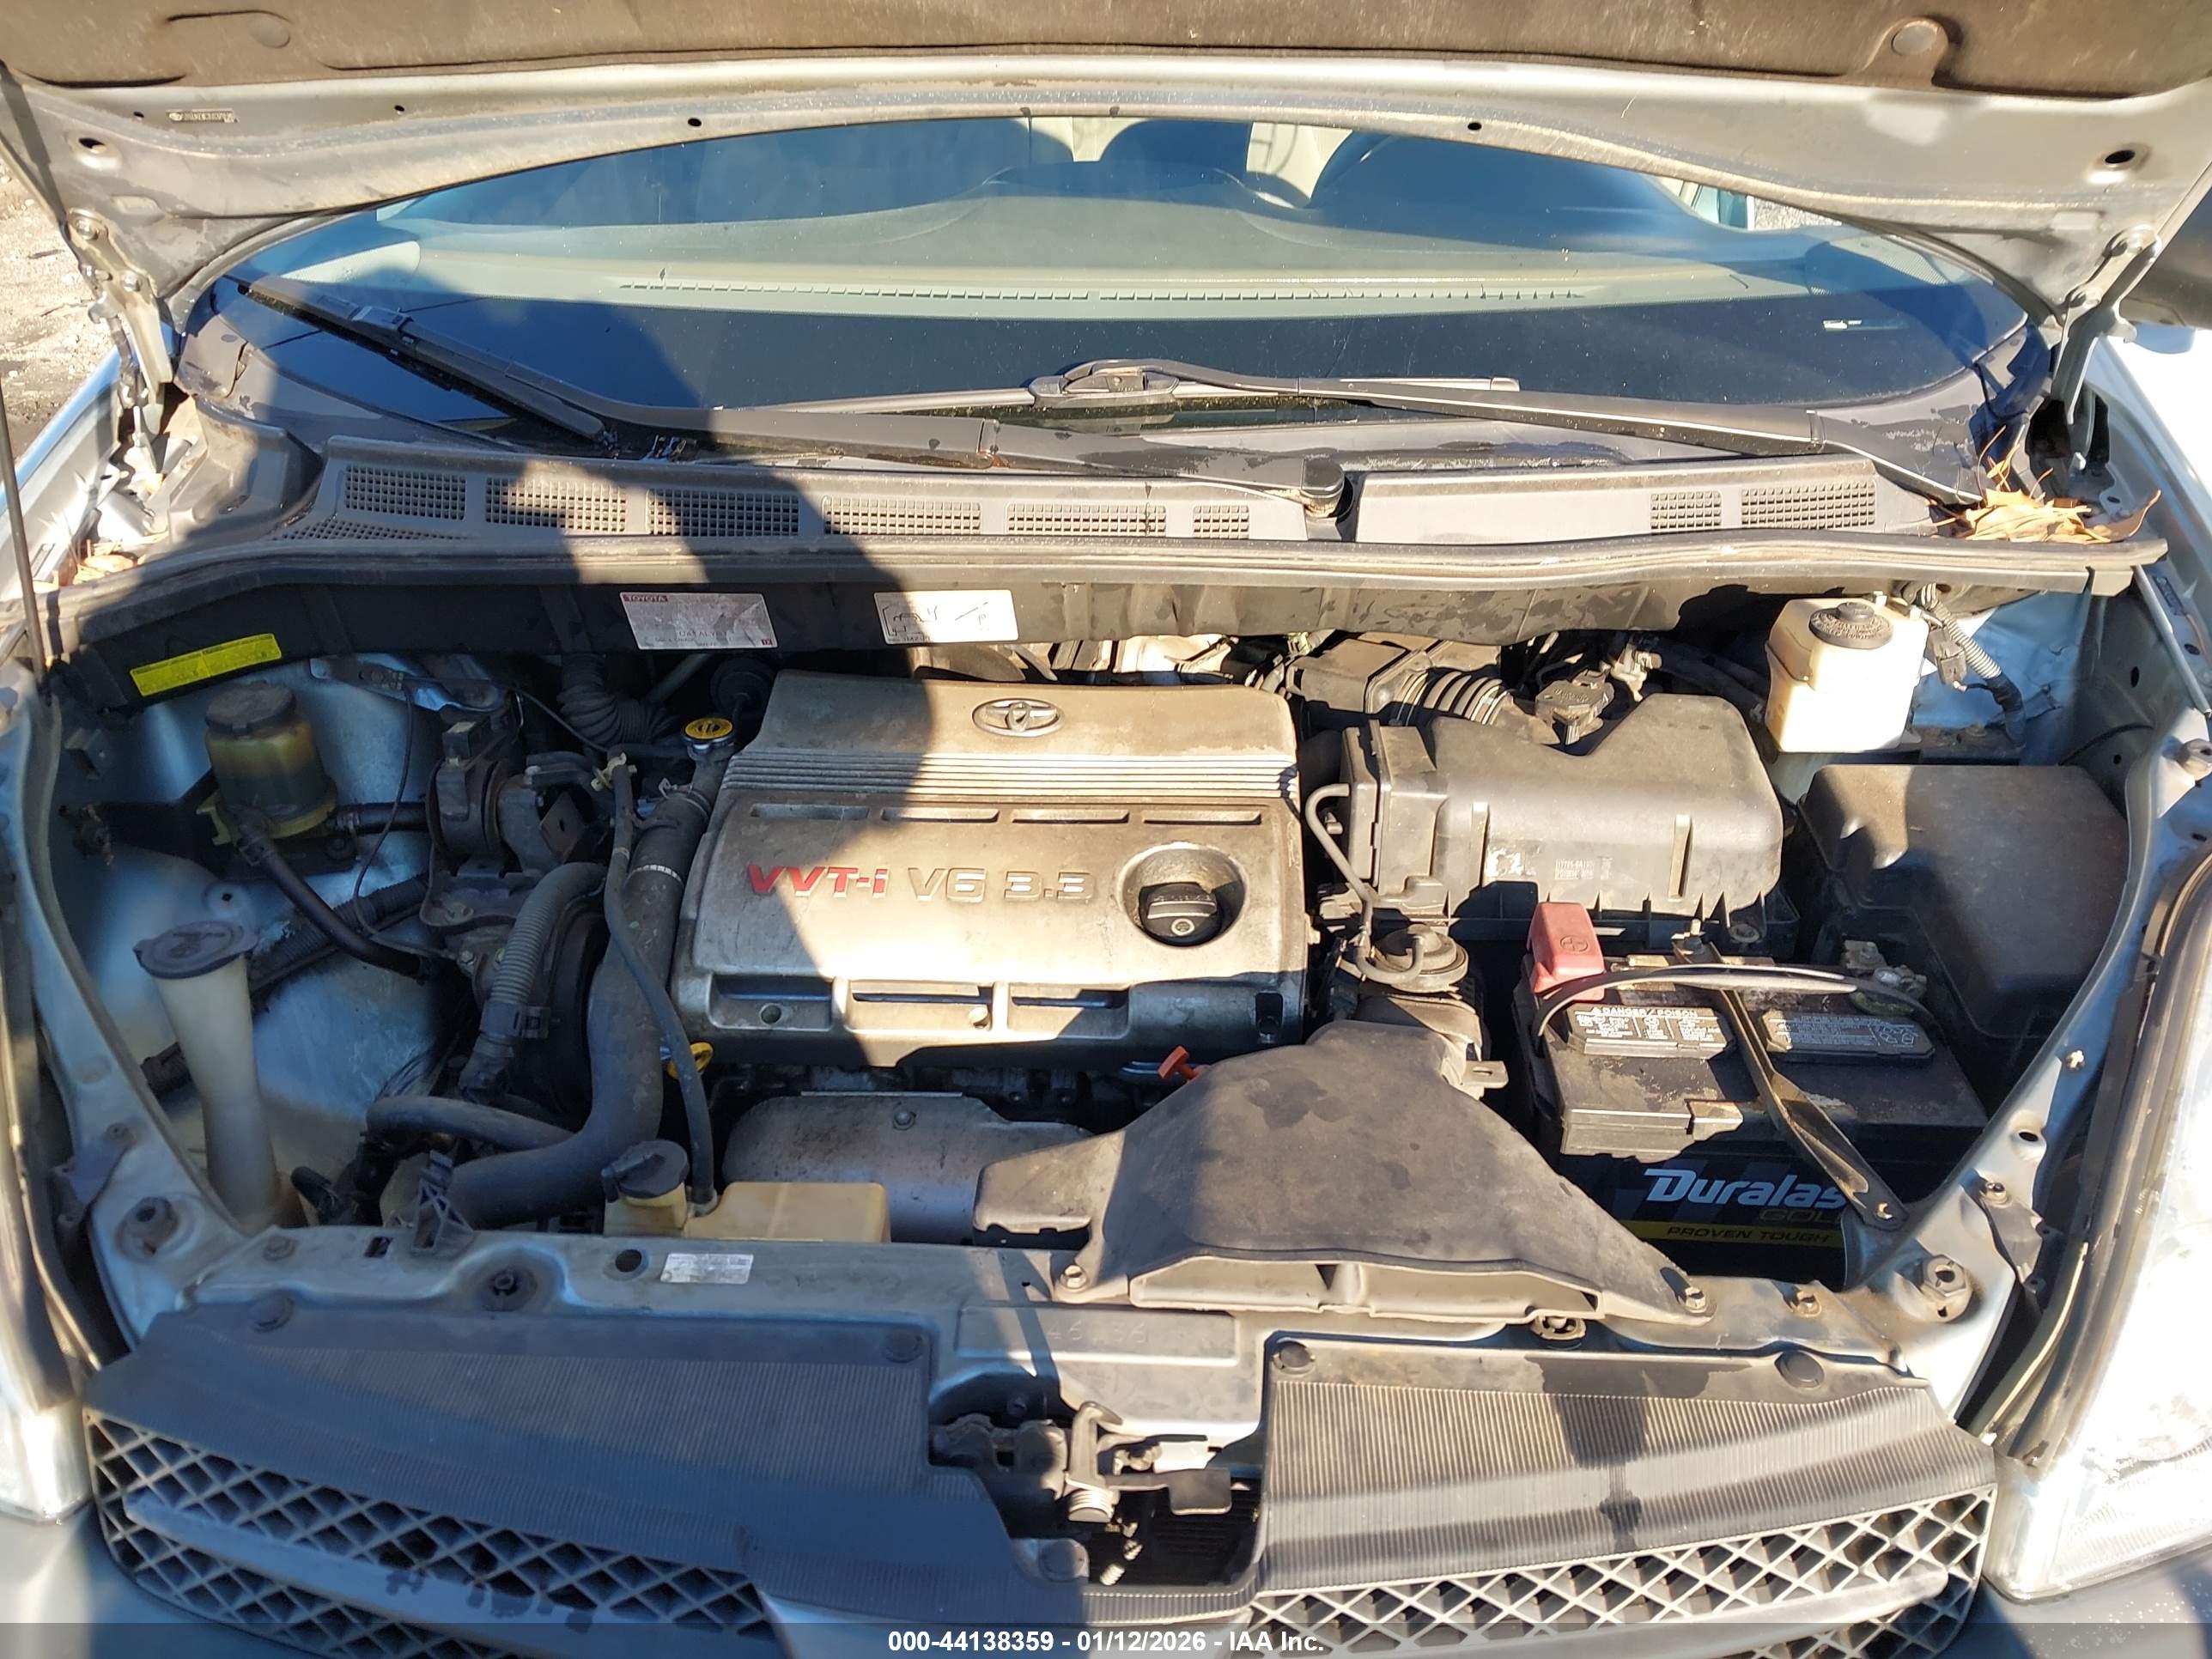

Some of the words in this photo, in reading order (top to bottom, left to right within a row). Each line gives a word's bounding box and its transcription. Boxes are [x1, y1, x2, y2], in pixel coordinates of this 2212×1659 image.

[748, 865, 890, 897] VVT-i
[908, 867, 987, 902] V6
[1004, 870, 1095, 902] 3.3
[1644, 1168, 1847, 1210] Duralas
[1759, 1208, 1842, 1224] GOL
[1666, 1226, 1753, 1239] PROVEN
[1760, 1231, 1831, 1243] TOUGH
